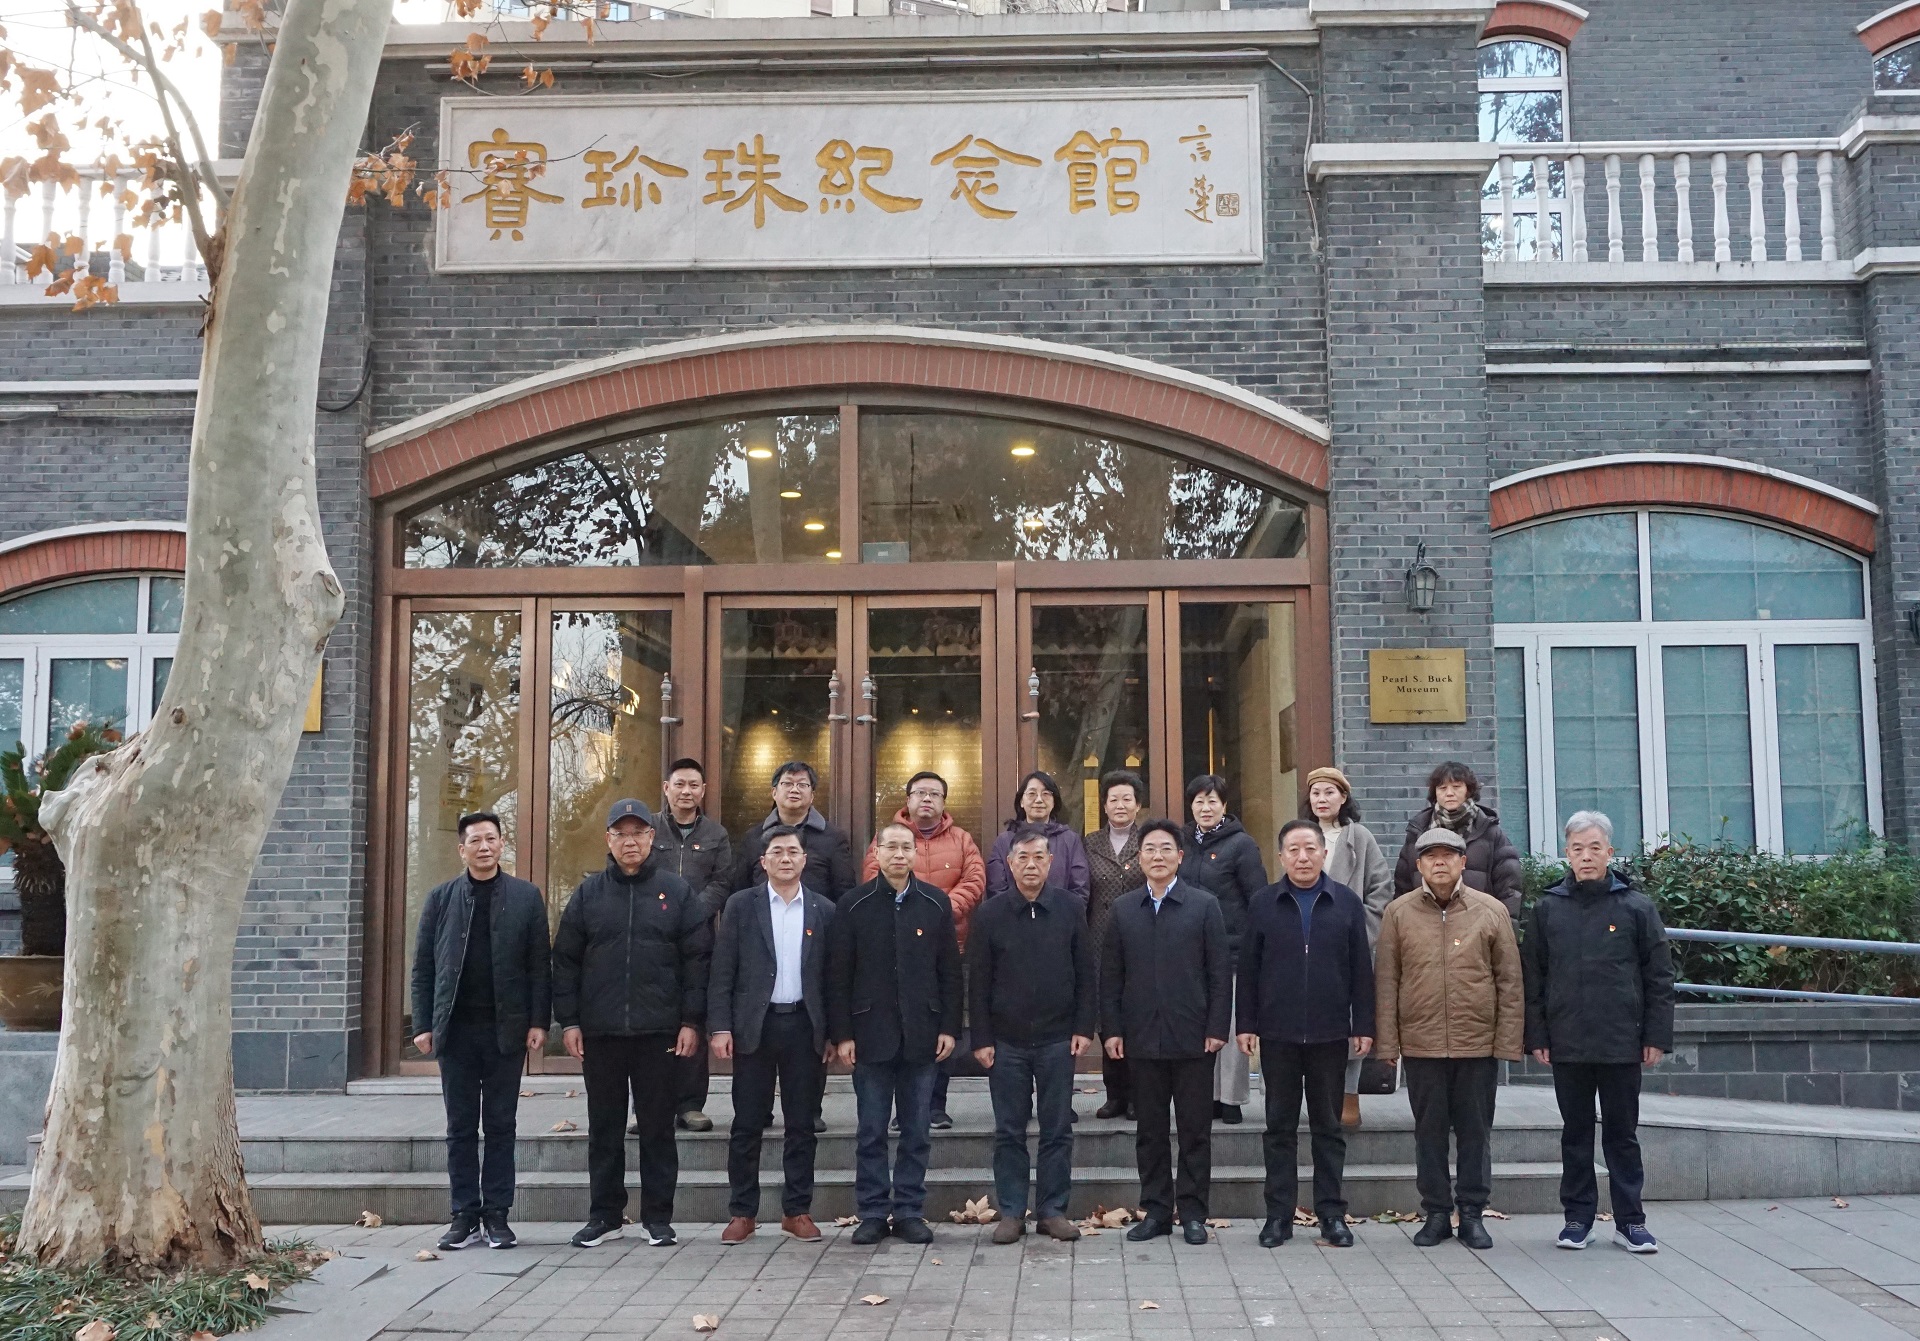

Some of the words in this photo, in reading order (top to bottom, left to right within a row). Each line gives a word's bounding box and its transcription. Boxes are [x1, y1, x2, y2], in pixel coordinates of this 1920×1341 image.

[1382, 675, 1408, 683] Pearl
[1412, 675, 1422, 683] S.
[1428, 674, 1453, 683] Buck
[1396, 685, 1439, 693] Museum
